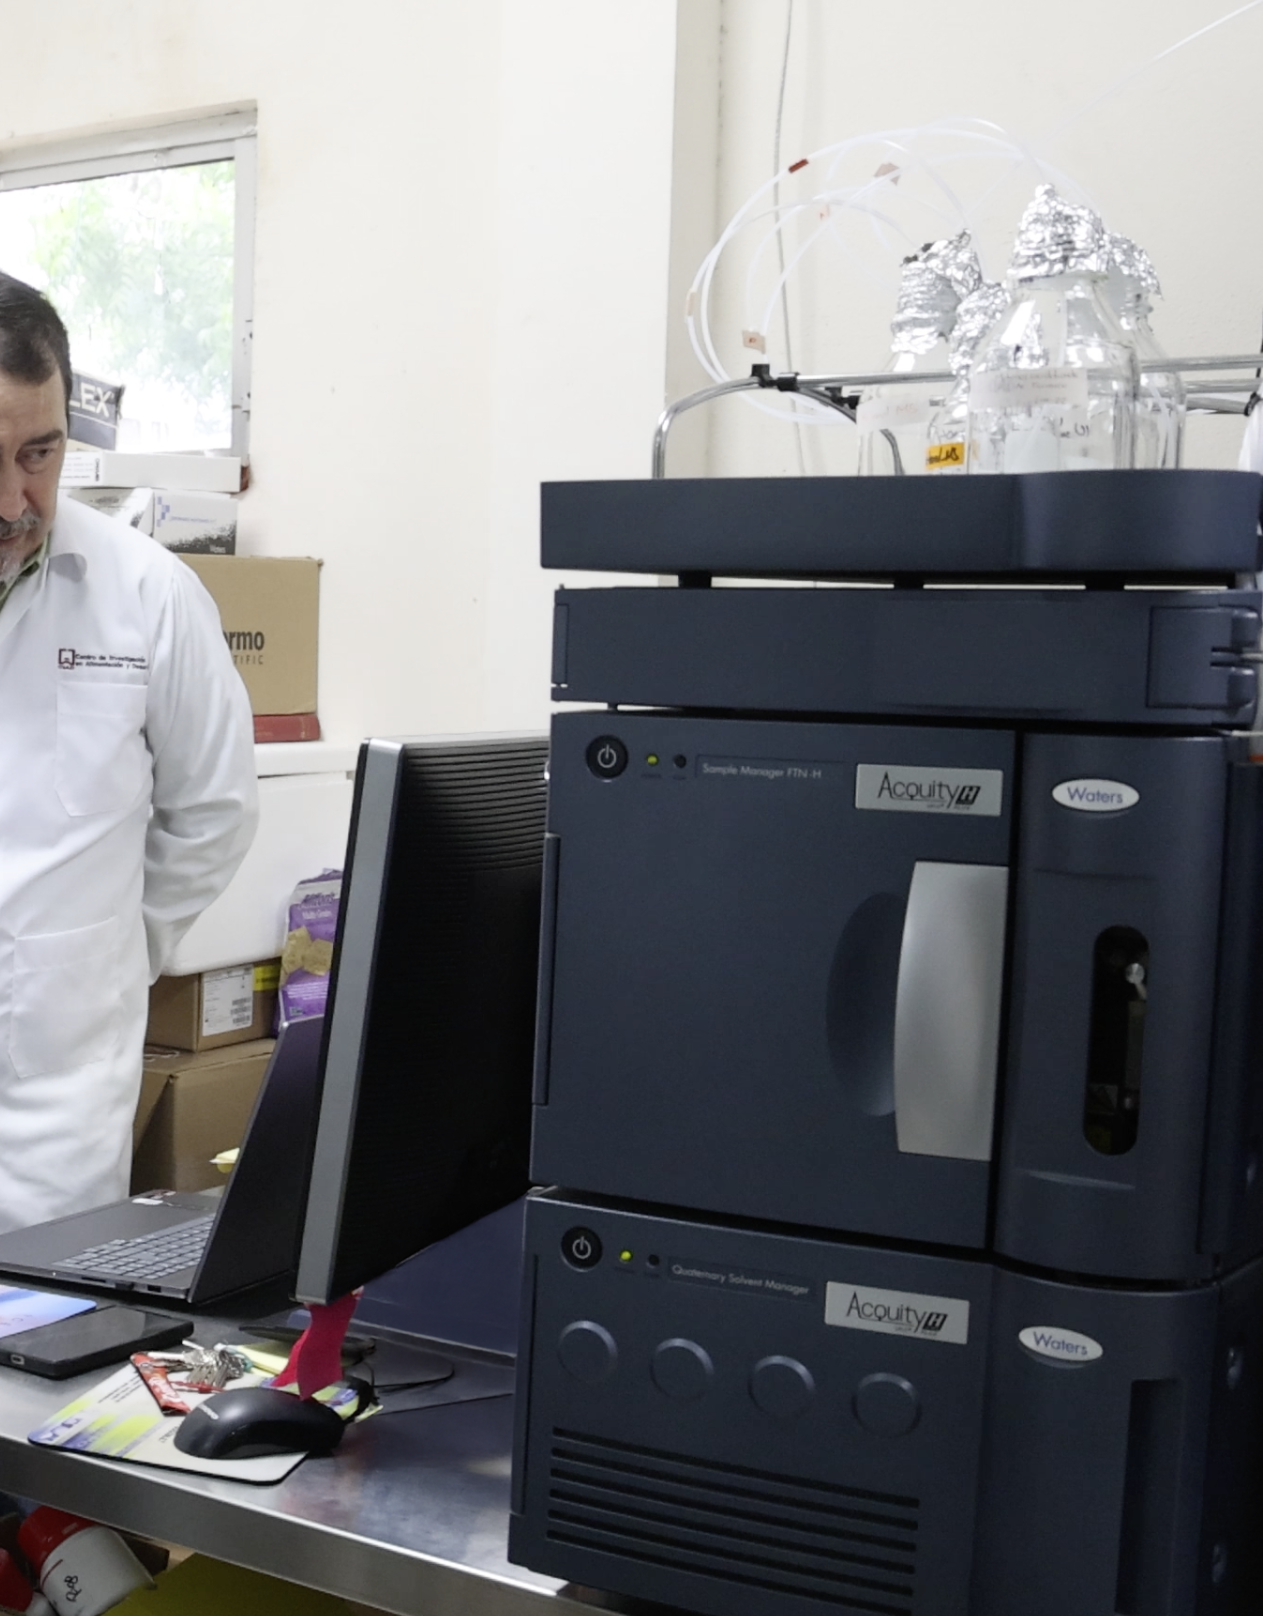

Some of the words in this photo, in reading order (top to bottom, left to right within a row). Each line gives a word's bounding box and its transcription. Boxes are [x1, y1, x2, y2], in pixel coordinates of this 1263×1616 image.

[69, 382, 111, 418] EX
[703, 763, 738, 776] Sample
[740, 765, 784, 780] Manager
[877, 771, 960, 809] Acquity
[1066, 786, 1124, 805] Waters
[671, 1264, 727, 1284] Quaternary
[728, 1273, 763, 1287] Solvent
[765, 1279, 810, 1296] Manager
[845, 1290, 926, 1333] Acquity
[1032, 1330, 1088, 1357] Waters
